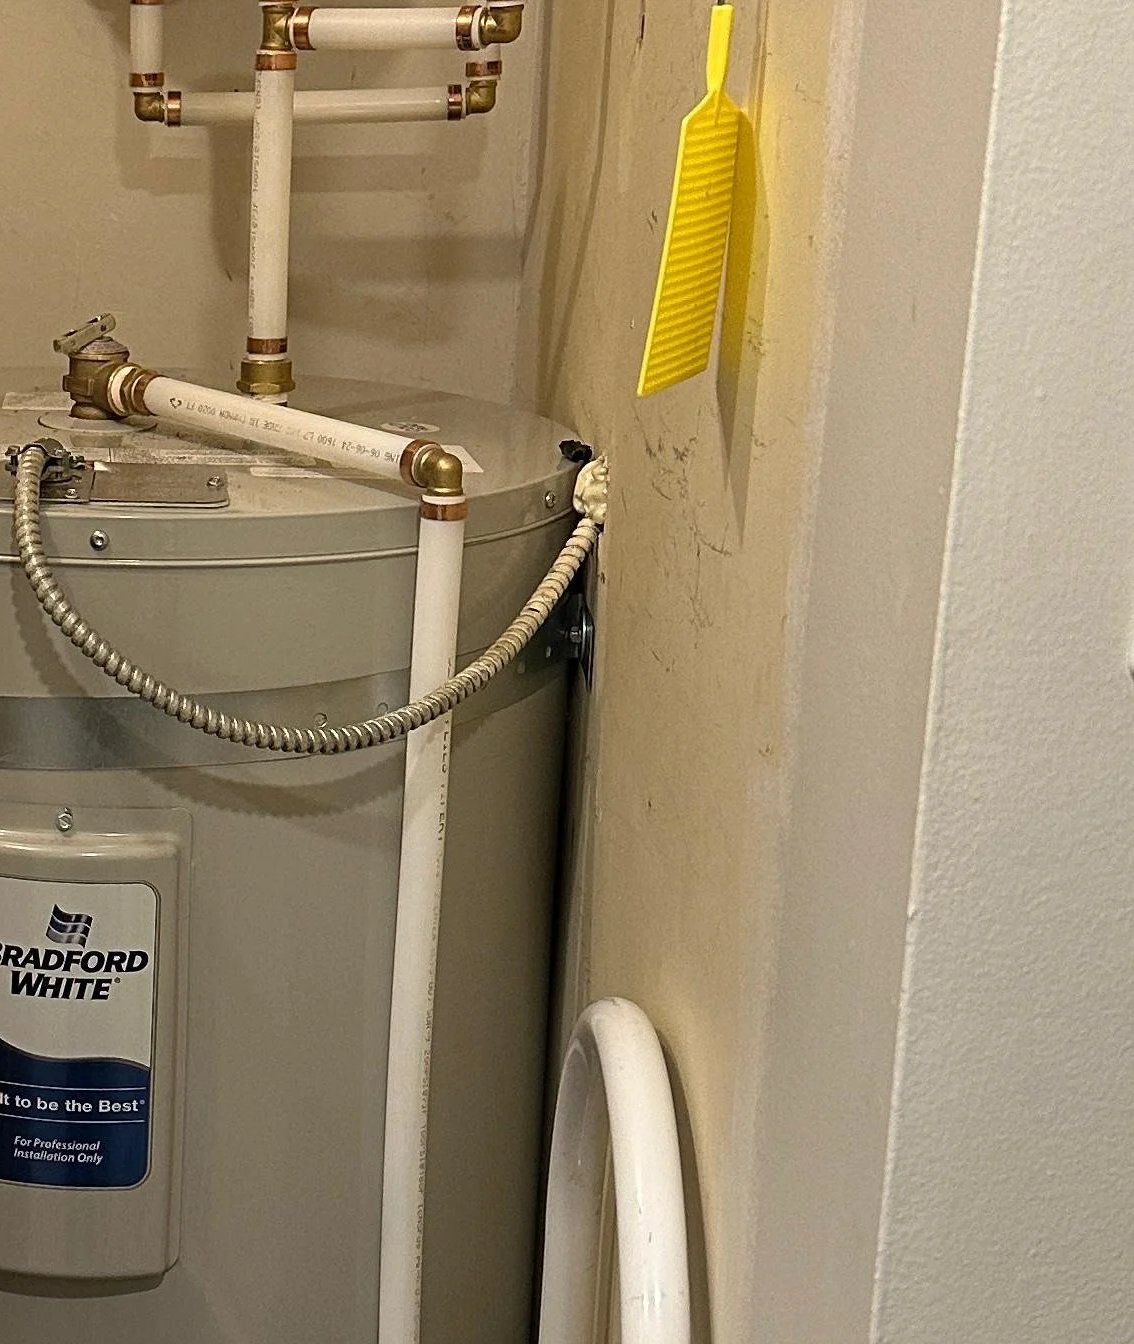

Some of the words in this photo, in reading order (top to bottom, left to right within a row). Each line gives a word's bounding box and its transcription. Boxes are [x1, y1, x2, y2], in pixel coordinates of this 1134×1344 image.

[14, 1092, 32, 1109] to
[36, 1094, 59, 1111] be
[64, 1095, 93, 1112] the
[98, 1097, 139, 1113] Best
[13, 1136, 31, 1148] For
[33, 1138, 100, 1151] Professional
[13, 1149, 75, 1163] Installation
[76, 1152, 103, 1166] Only
